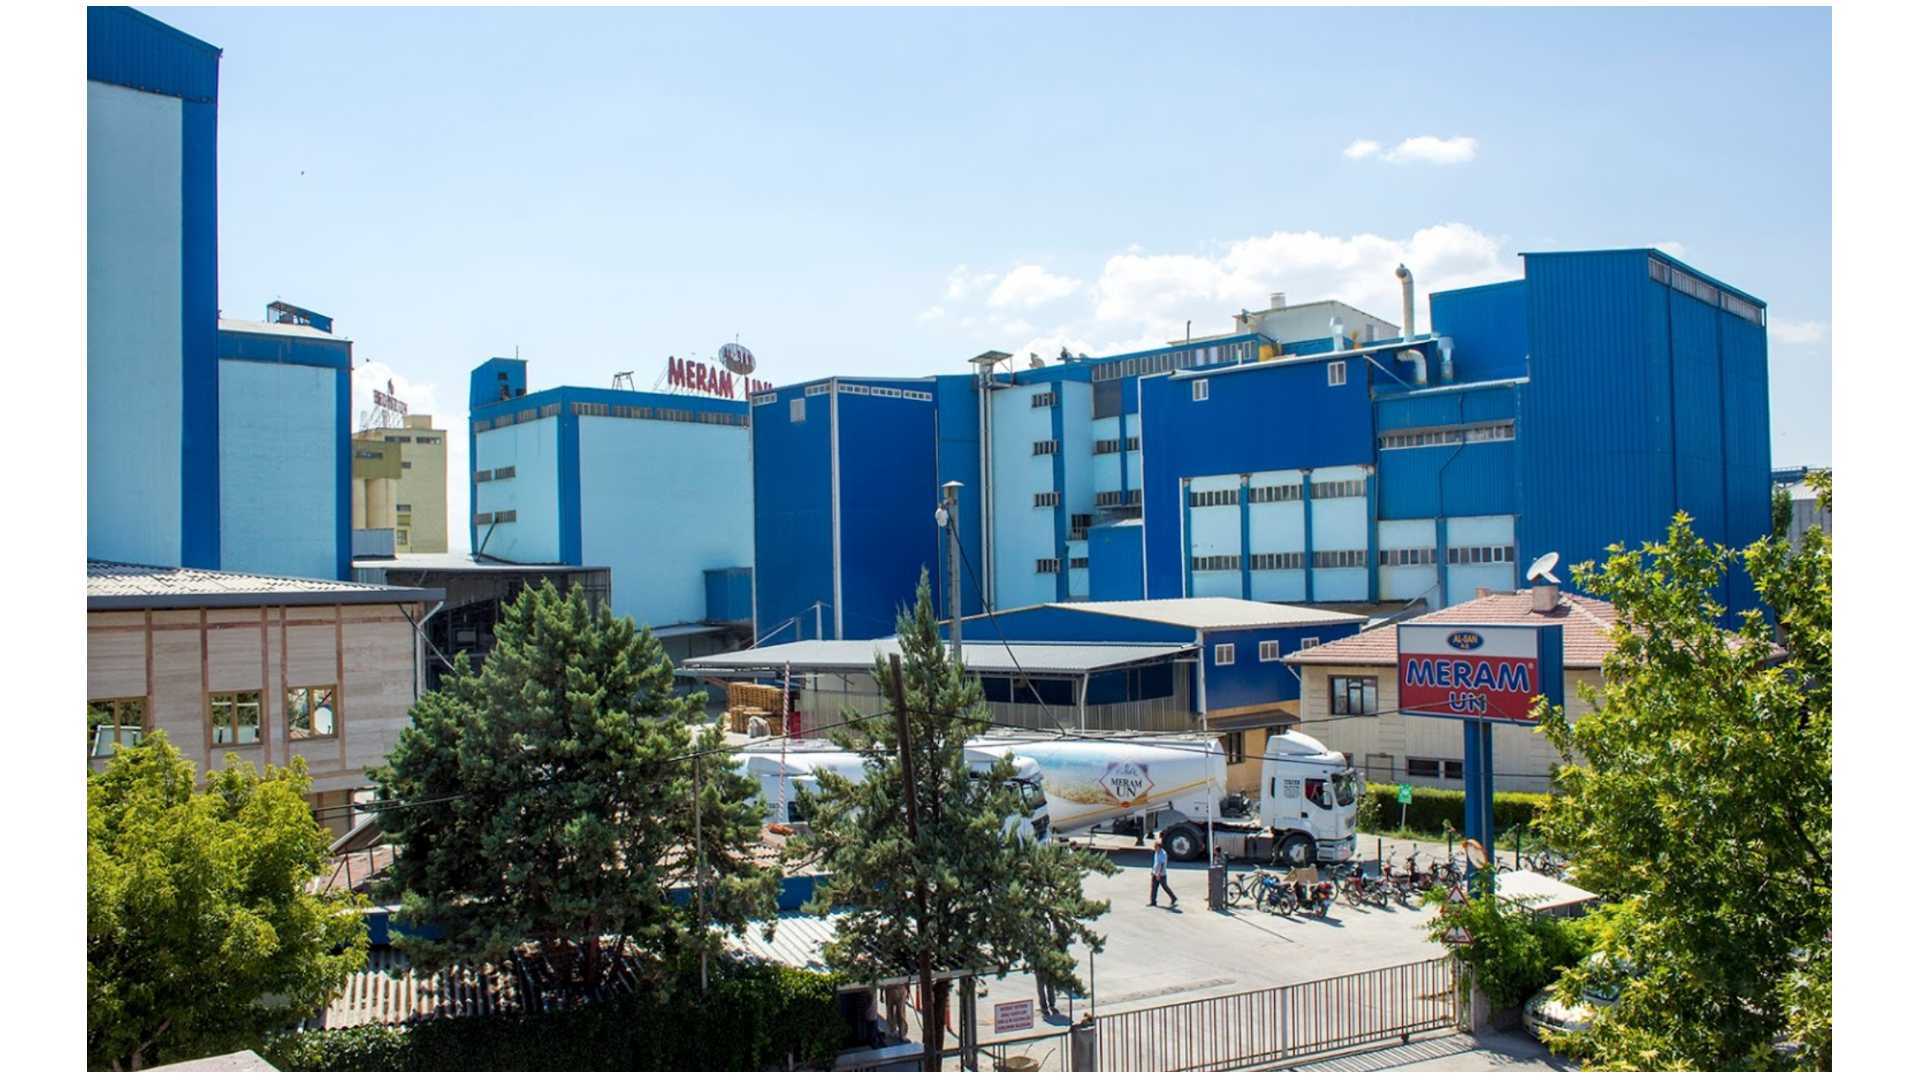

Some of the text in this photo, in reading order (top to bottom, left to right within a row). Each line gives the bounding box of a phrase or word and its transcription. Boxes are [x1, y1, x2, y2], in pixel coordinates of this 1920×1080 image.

[668, 355, 734, 399] MERAM
[1406, 658, 1530, 693] MERAM
[1449, 692, 1487, 714] UN
[1111, 778, 1143, 788] MERAM
[1116, 785, 1137, 798] UN
